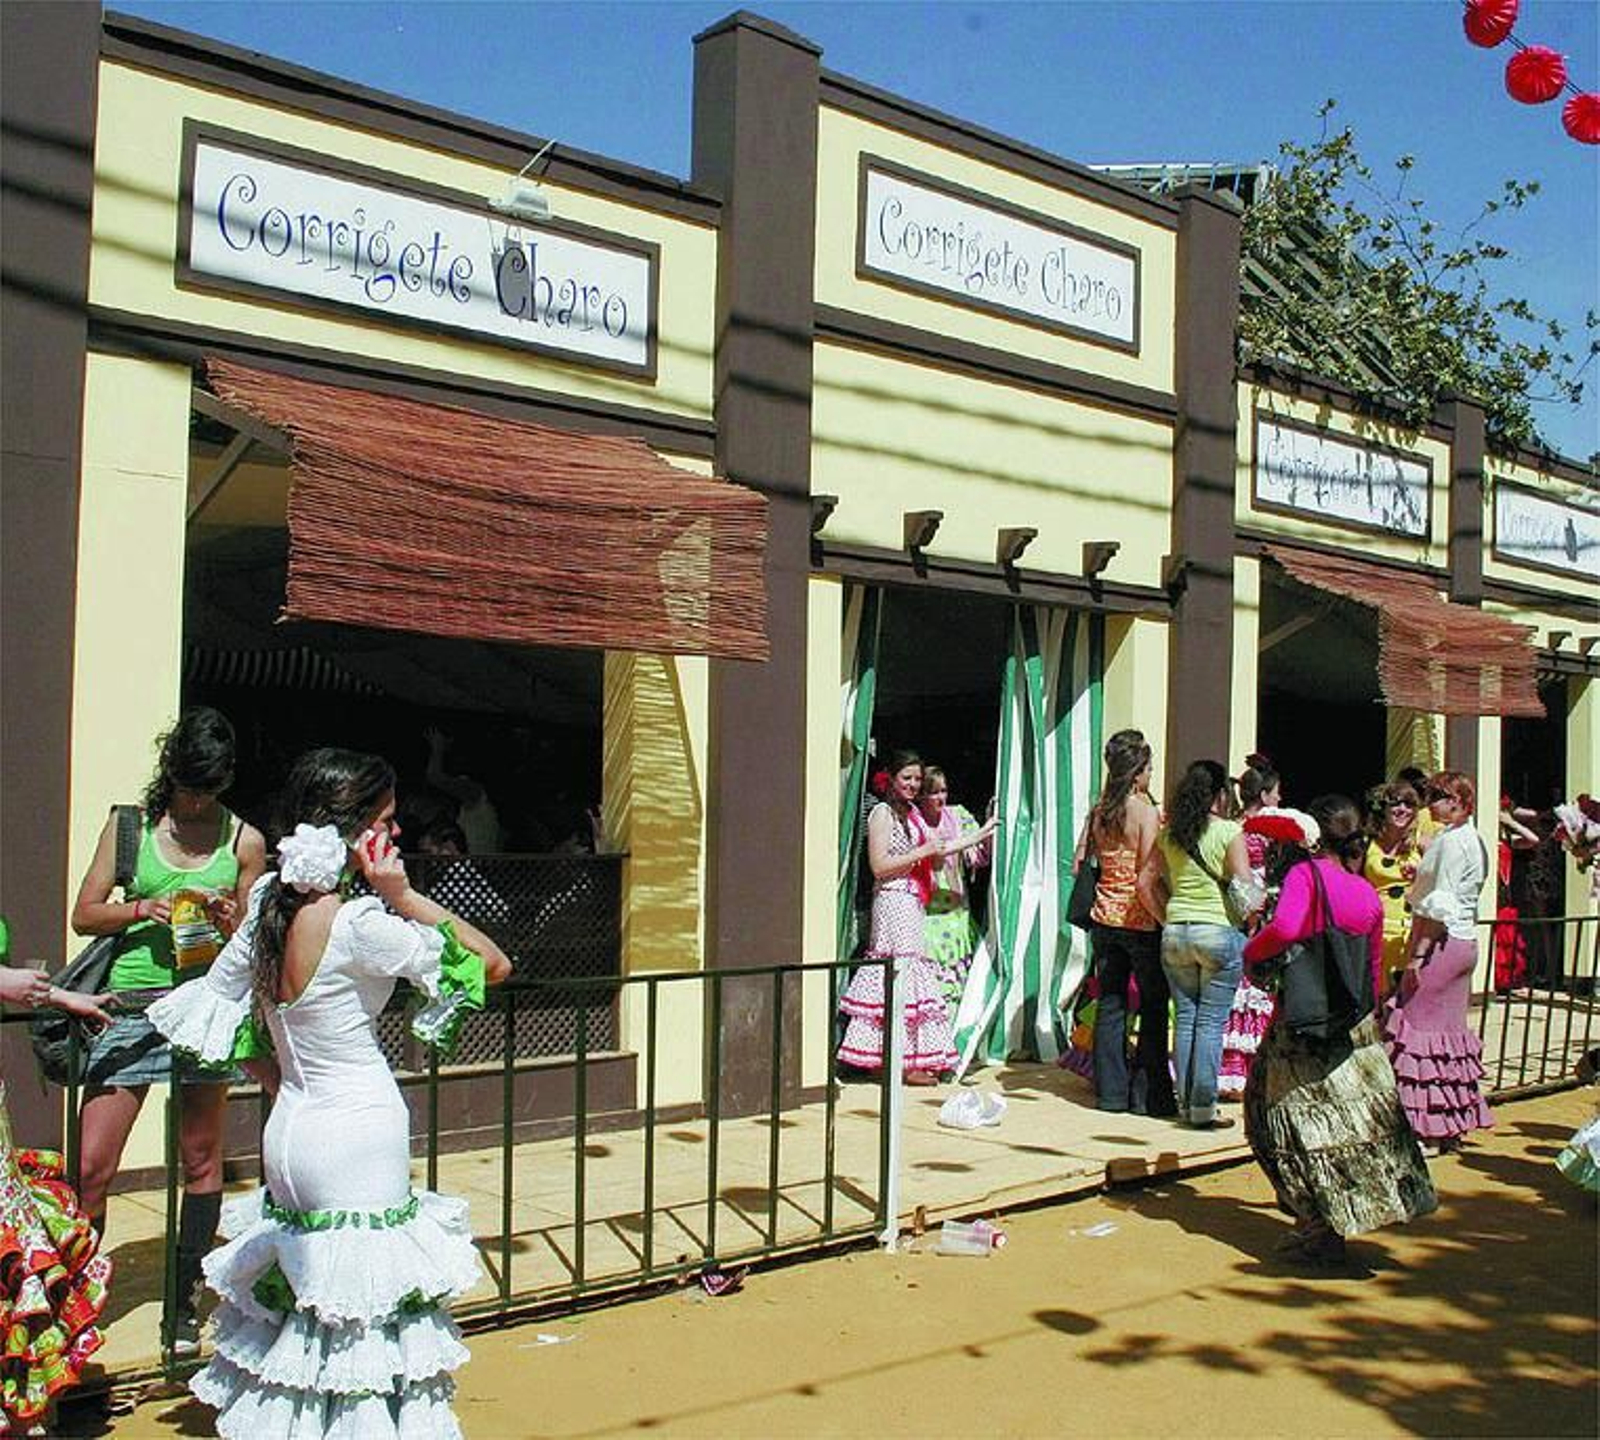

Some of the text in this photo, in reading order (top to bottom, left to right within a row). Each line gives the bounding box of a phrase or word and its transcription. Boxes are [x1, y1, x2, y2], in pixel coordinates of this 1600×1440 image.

[217, 173, 628, 337] Corrigete Charo
[879, 197, 1122, 321] Corrigete Charo
